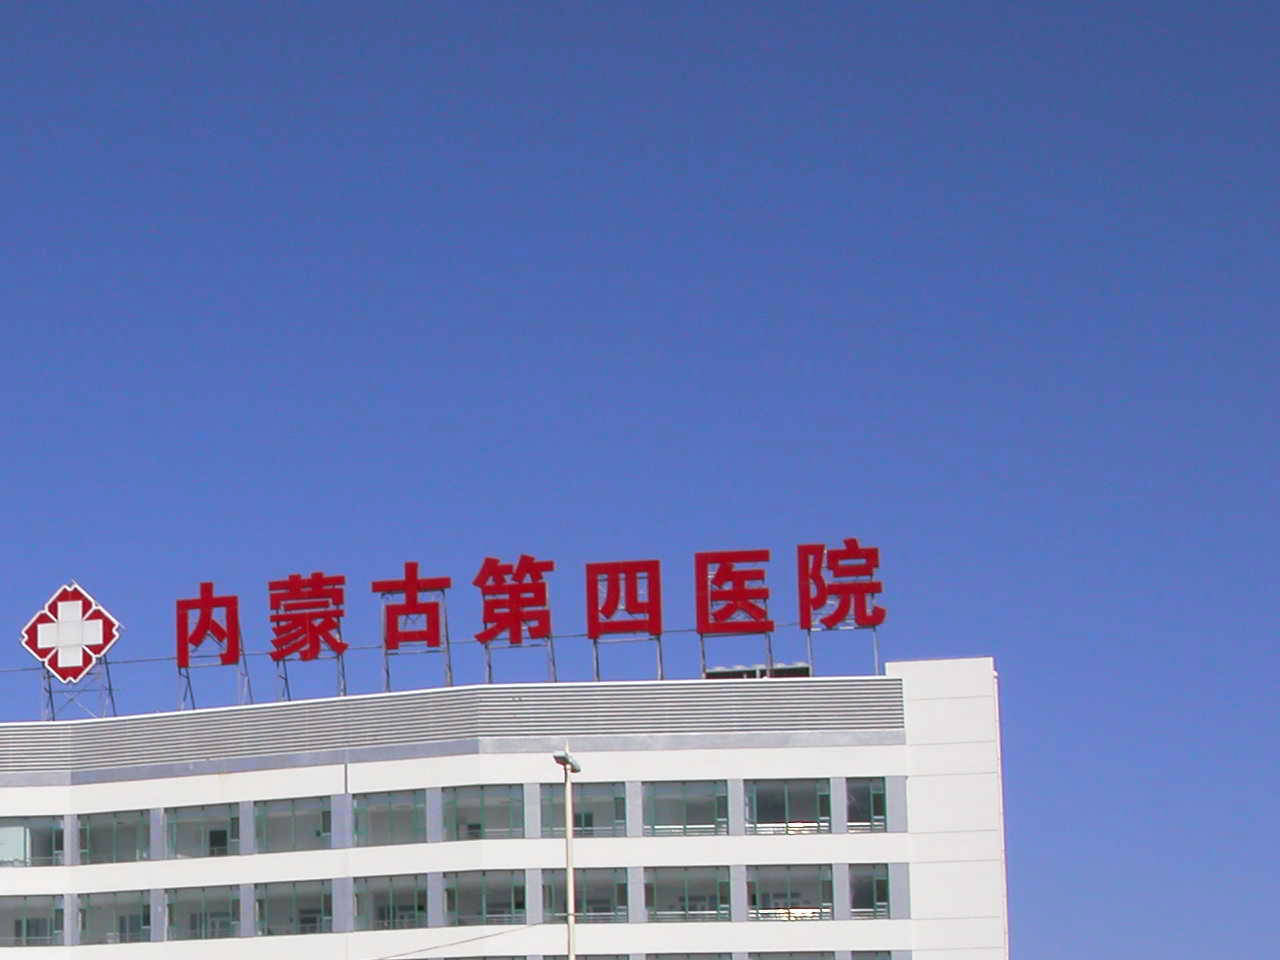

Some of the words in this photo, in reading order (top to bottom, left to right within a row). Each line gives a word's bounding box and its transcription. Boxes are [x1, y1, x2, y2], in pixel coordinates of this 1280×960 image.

[176, 538, 886, 668] 内蒙古第四医院
